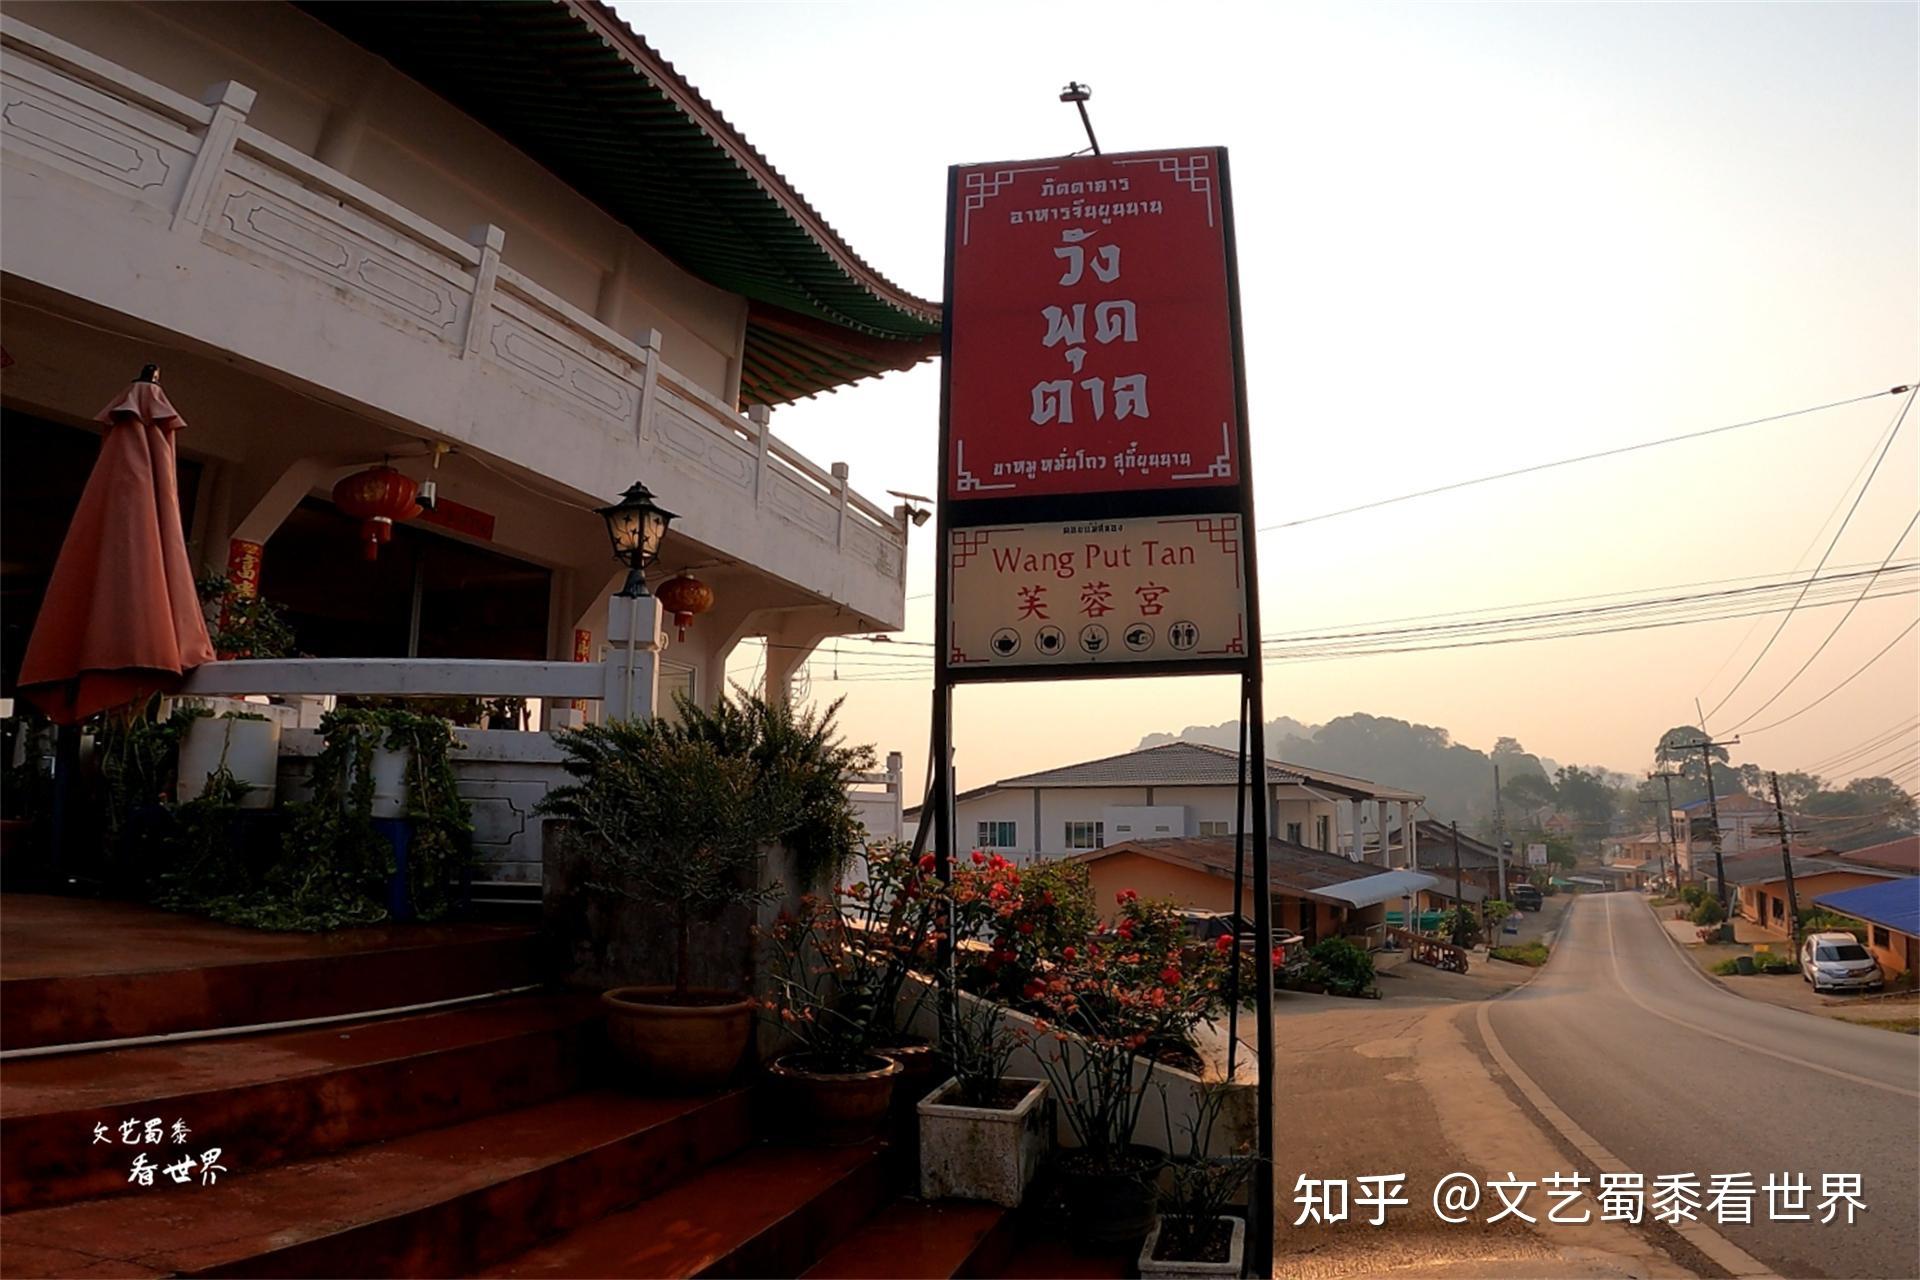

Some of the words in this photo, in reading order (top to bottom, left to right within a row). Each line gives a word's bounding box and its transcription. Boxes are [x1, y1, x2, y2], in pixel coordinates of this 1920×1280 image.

[1053, 227, 1121, 286] วัง
[1040, 299, 1139, 374] พุด
[1029, 373, 1150, 425] ตาล
[991, 547, 1075, 579] Wang
[1085, 544, 1132, 570] Put
[1141, 540, 1196, 567] Tan
